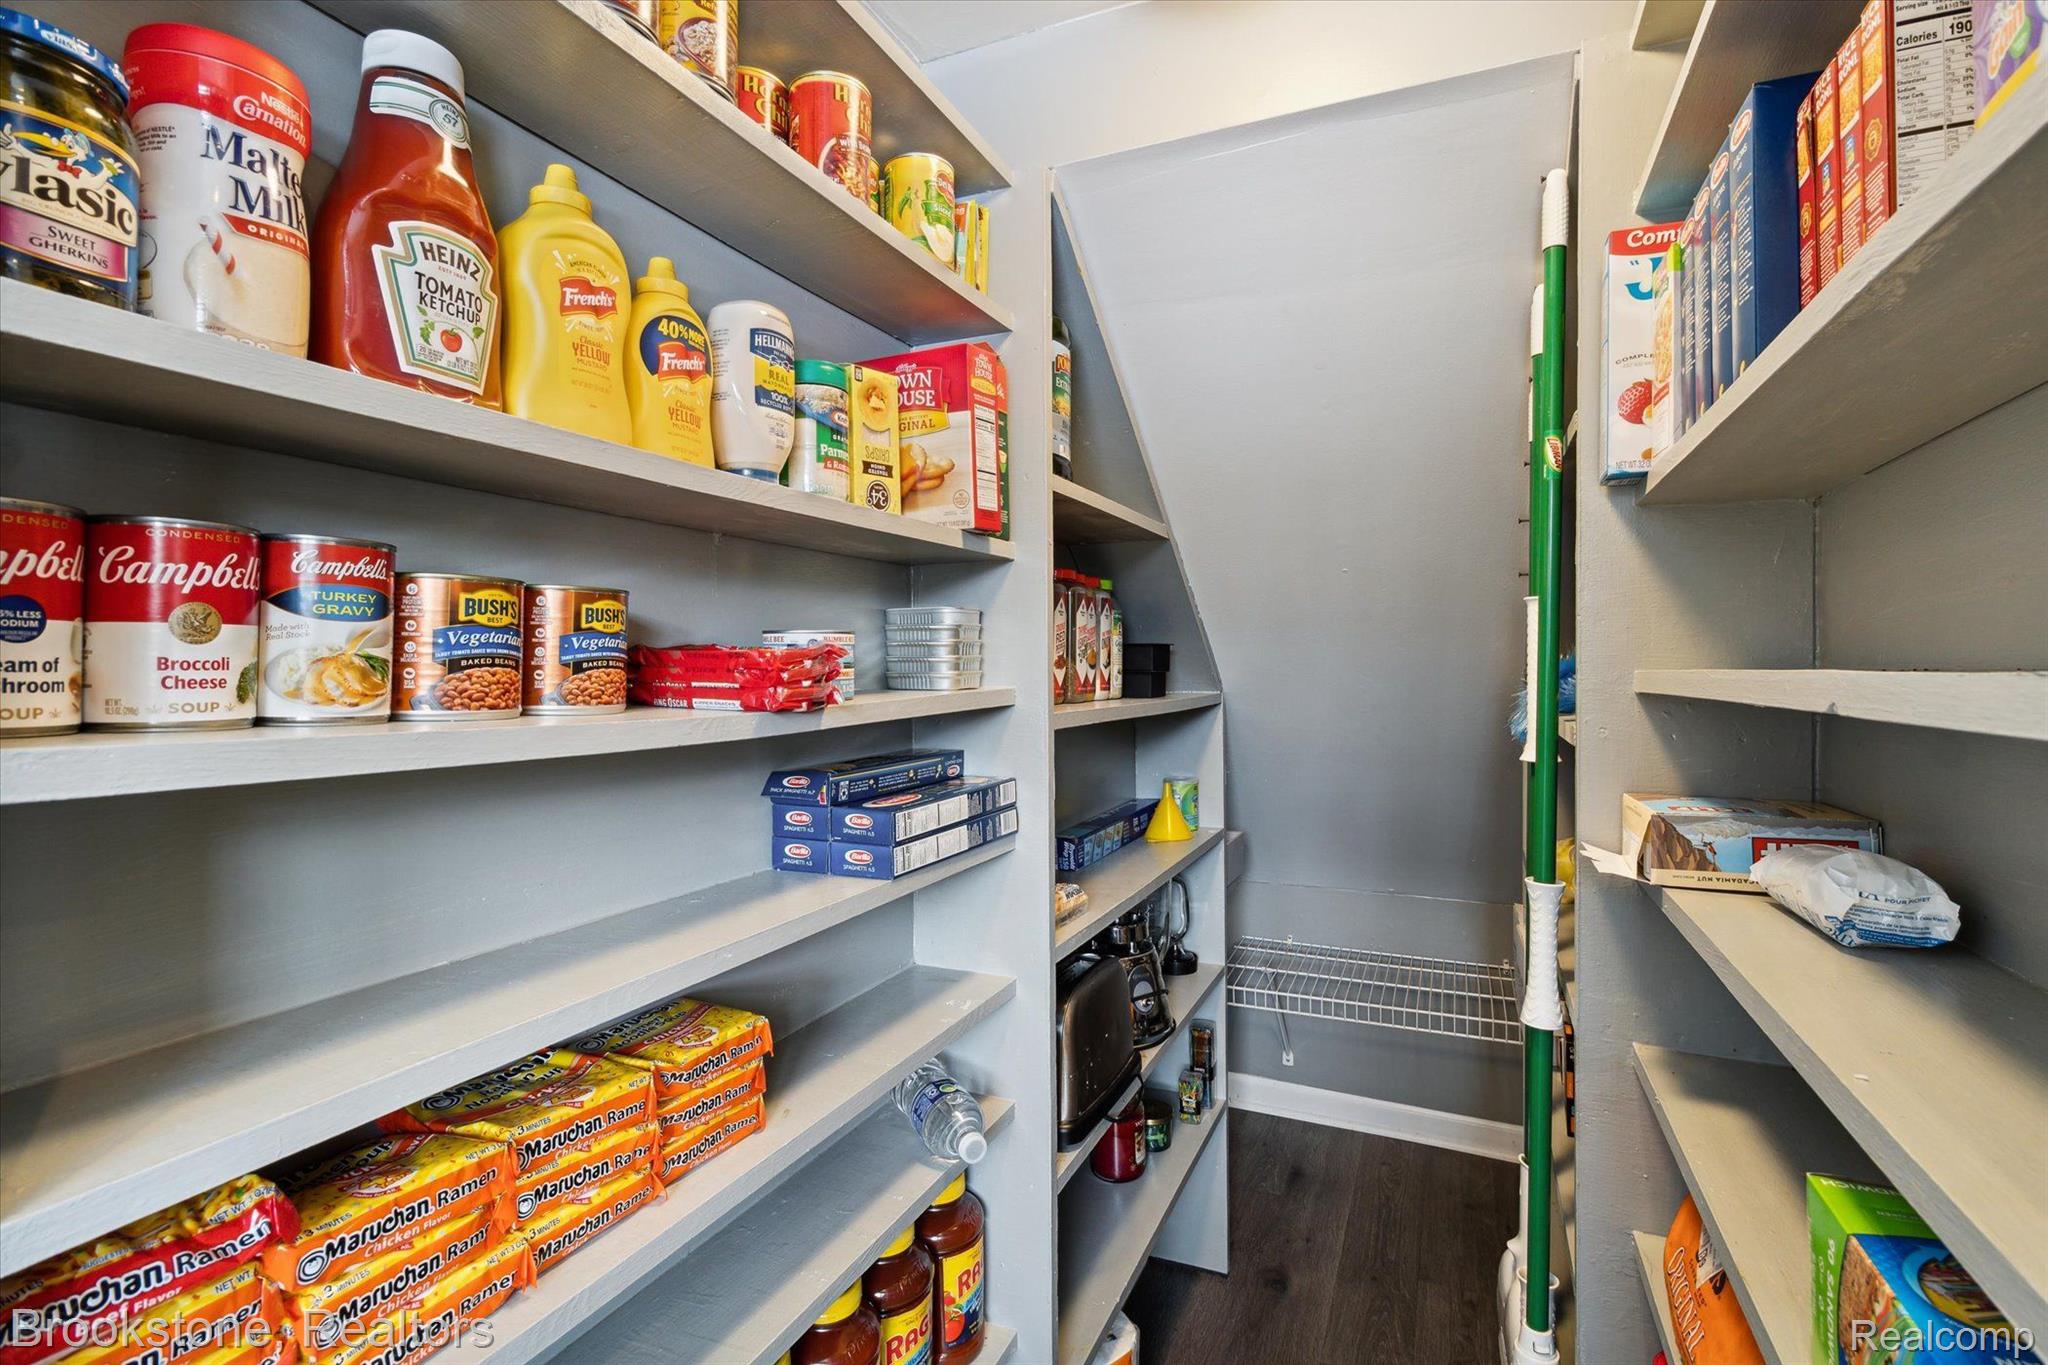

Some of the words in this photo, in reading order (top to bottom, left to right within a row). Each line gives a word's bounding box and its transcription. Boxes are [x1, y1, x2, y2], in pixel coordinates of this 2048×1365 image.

[1896, 3, 1916, 12] Serving
[1949, 20, 1973, 35] 190
[1896, 31, 1938, 46] Calories
[1838, 35, 1857, 68] RICE
[1838, 52, 1858, 86] RONI
[1815, 67, 1832, 99] RICE
[1815, 84, 1832, 115] RONI
[233, 95, 307, 149] Carnation
[443, 113, 458, 127] 57
[200, 122, 302, 199] Malte
[229, 175, 307, 236] Milk
[48, 226, 96, 250] SWEET
[29, 236, 109, 269] GHERKINS
[420, 241, 481, 282] HEINZ
[415, 271, 482, 313] TOMATO
[563, 288, 613, 307] French's
[420, 292, 480, 325] KETCHUP
[658, 318, 689, 339] 40%
[579, 336, 604, 349] Classic
[572, 342, 610, 366] YELLOW
[661, 352, 705, 372] French's
[1616, 352, 1655, 366] COMPLE
[577, 357, 607, 372] MUSTARD
[769, 371, 789, 386] REAL
[668, 406, 702, 430] YELLOW
[900, 419, 936, 432] GINAL
[865, 445, 890, 462] CRISPS
[2, 513, 69, 529] DENSED
[145, 528, 241, 543] CONDENSED
[98, 545, 261, 594] Campbell's
[291, 550, 387, 580] Campbell's
[311, 591, 377, 604] TURKEY
[16, 610, 41, 619] LESS
[312, 604, 376, 617] GRAVY
[464, 598, 518, 620] BUSH'S
[585, 608, 625, 626] BUSH'S
[0, 620, 39, 628] ODIUM
[265, 624, 288, 633] Made
[265, 632, 284, 641] Real
[285, 631, 311, 640] Stock
[447, 630, 521, 647] Vegetarian
[43, 657, 59, 673] of
[156, 656, 230, 671] Broccoli
[461, 658, 492, 666] BAKED
[494, 658, 515, 666] BEANS
[2, 678, 64, 694] hroom
[160, 675, 227, 690] Cheese
[168, 702, 220, 714] SOUP
[667, 698, 688, 708] OSCAR
[0, 707, 43, 720] OUP
[791, 814, 810, 822] Barilla
[843, 828, 866, 836] SPAGHETTI
[851, 853, 871, 861] Barilla
[843, 864, 867, 872] SPAGHETTI
[670, 1052, 727, 1083] Maruchan
[629, 1079, 639, 1088] NET
[692, 1070, 722, 1088] Chicken
[660, 1095, 722, 1128] Maruchan
[517, 1125, 525, 1136] 3
[525, 1117, 552, 1132] MINUTES
[525, 1119, 603, 1160] Maruchan
[555, 1137, 595, 1161] Chicken
[465, 1150, 480, 1161] NET
[669, 1131, 722, 1168] Maruchan
[534, 1160, 560, 1176] MINUTES
[533, 1162, 610, 1203] Maruchan
[208, 1211, 230, 1225] NET
[323, 1198, 430, 1257] Maruchan
[436, 1167, 497, 1209] Ramen
[303, 1228, 314, 1238] 3
[316, 1212, 353, 1233] MINUTES
[363, 1225, 421, 1257] Chicken
[423, 1210, 453, 1231] Flavor
[529, 1228, 538, 1240] 3
[537, 1218, 561, 1236] MINUTES
[537, 1209, 610, 1262] Maruchan
[174, 1221, 273, 1275] Ramen
[81, 1248, 129, 1270] SUGGESTED
[487, 1254, 500, 1266] NET
[214, 1280, 234, 1294] NET
[235, 1271, 253, 1284] WT.
[323, 1285, 333, 1297] 3
[337, 1270, 370, 1292] MINUTES
[339, 1254, 443, 1320] Maruchan
[377, 1281, 434, 1318] Chicken
[1668, 1246, 1705, 1362] ORIGINAL
[76, 1305, 129, 1337] Beef
[133, 1286, 183, 1313] Flavor
[885, 1313, 929, 1365] RAG
